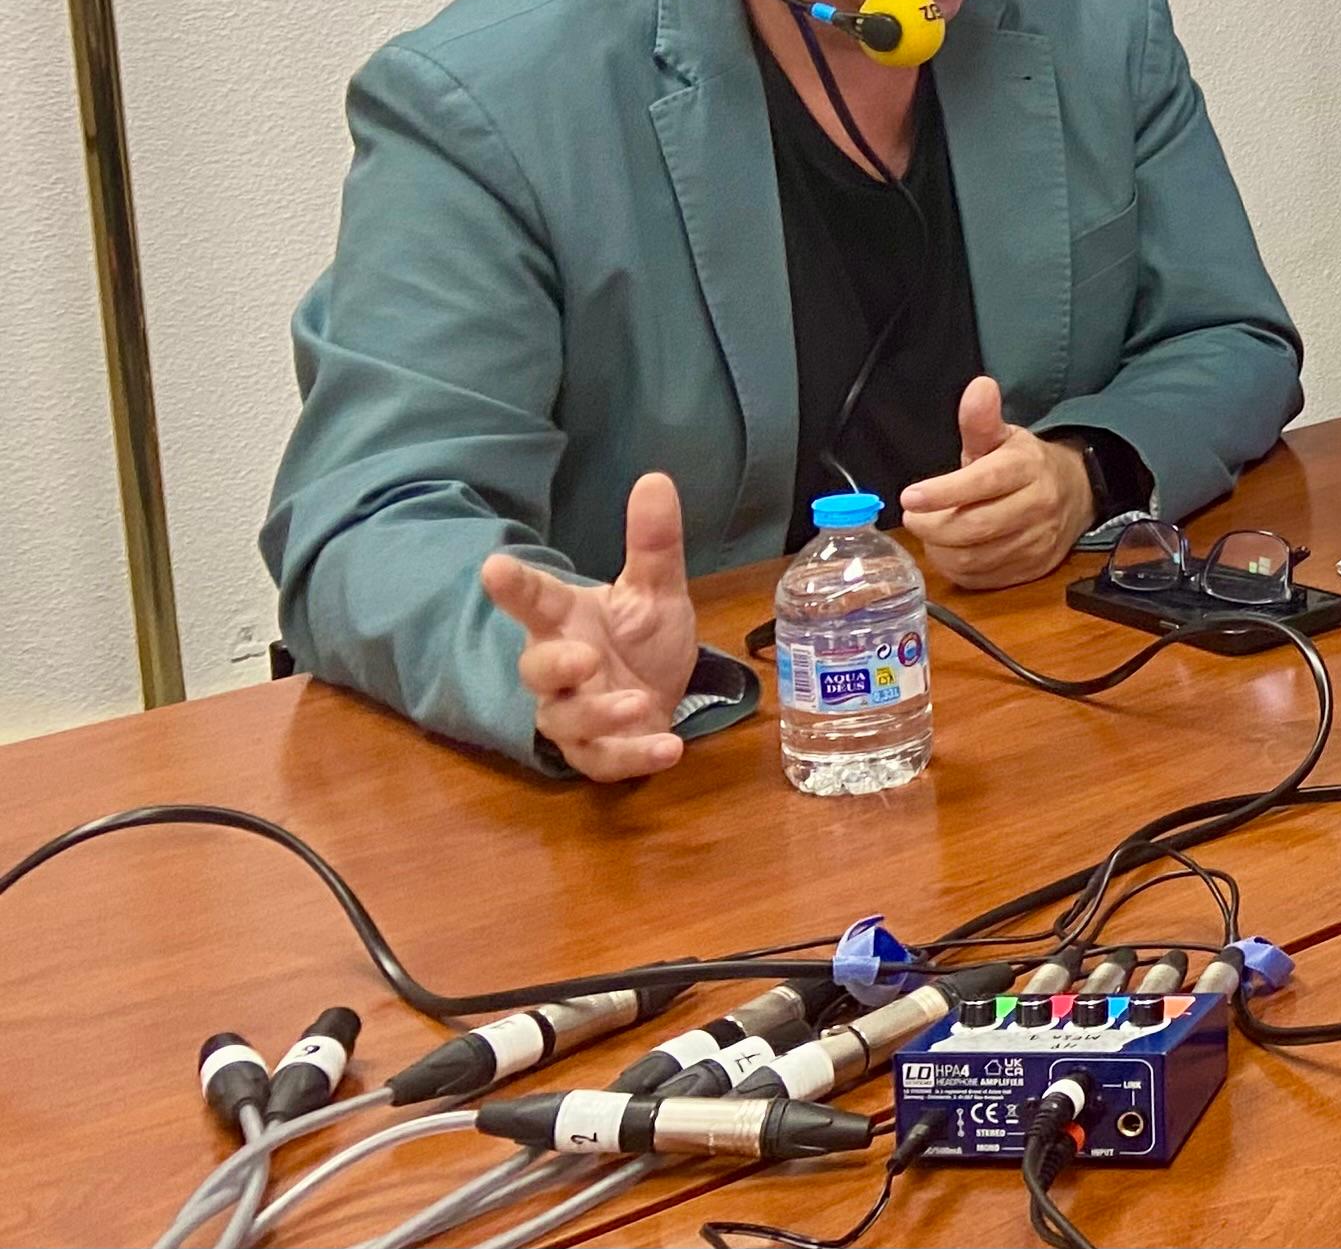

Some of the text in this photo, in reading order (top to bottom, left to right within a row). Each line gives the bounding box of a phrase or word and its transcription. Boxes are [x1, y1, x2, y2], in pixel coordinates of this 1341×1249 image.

[823, 671, 867, 685] AQUA
[825, 682, 866, 694] DEUS
[935, 1063, 970, 1078] HPA4
